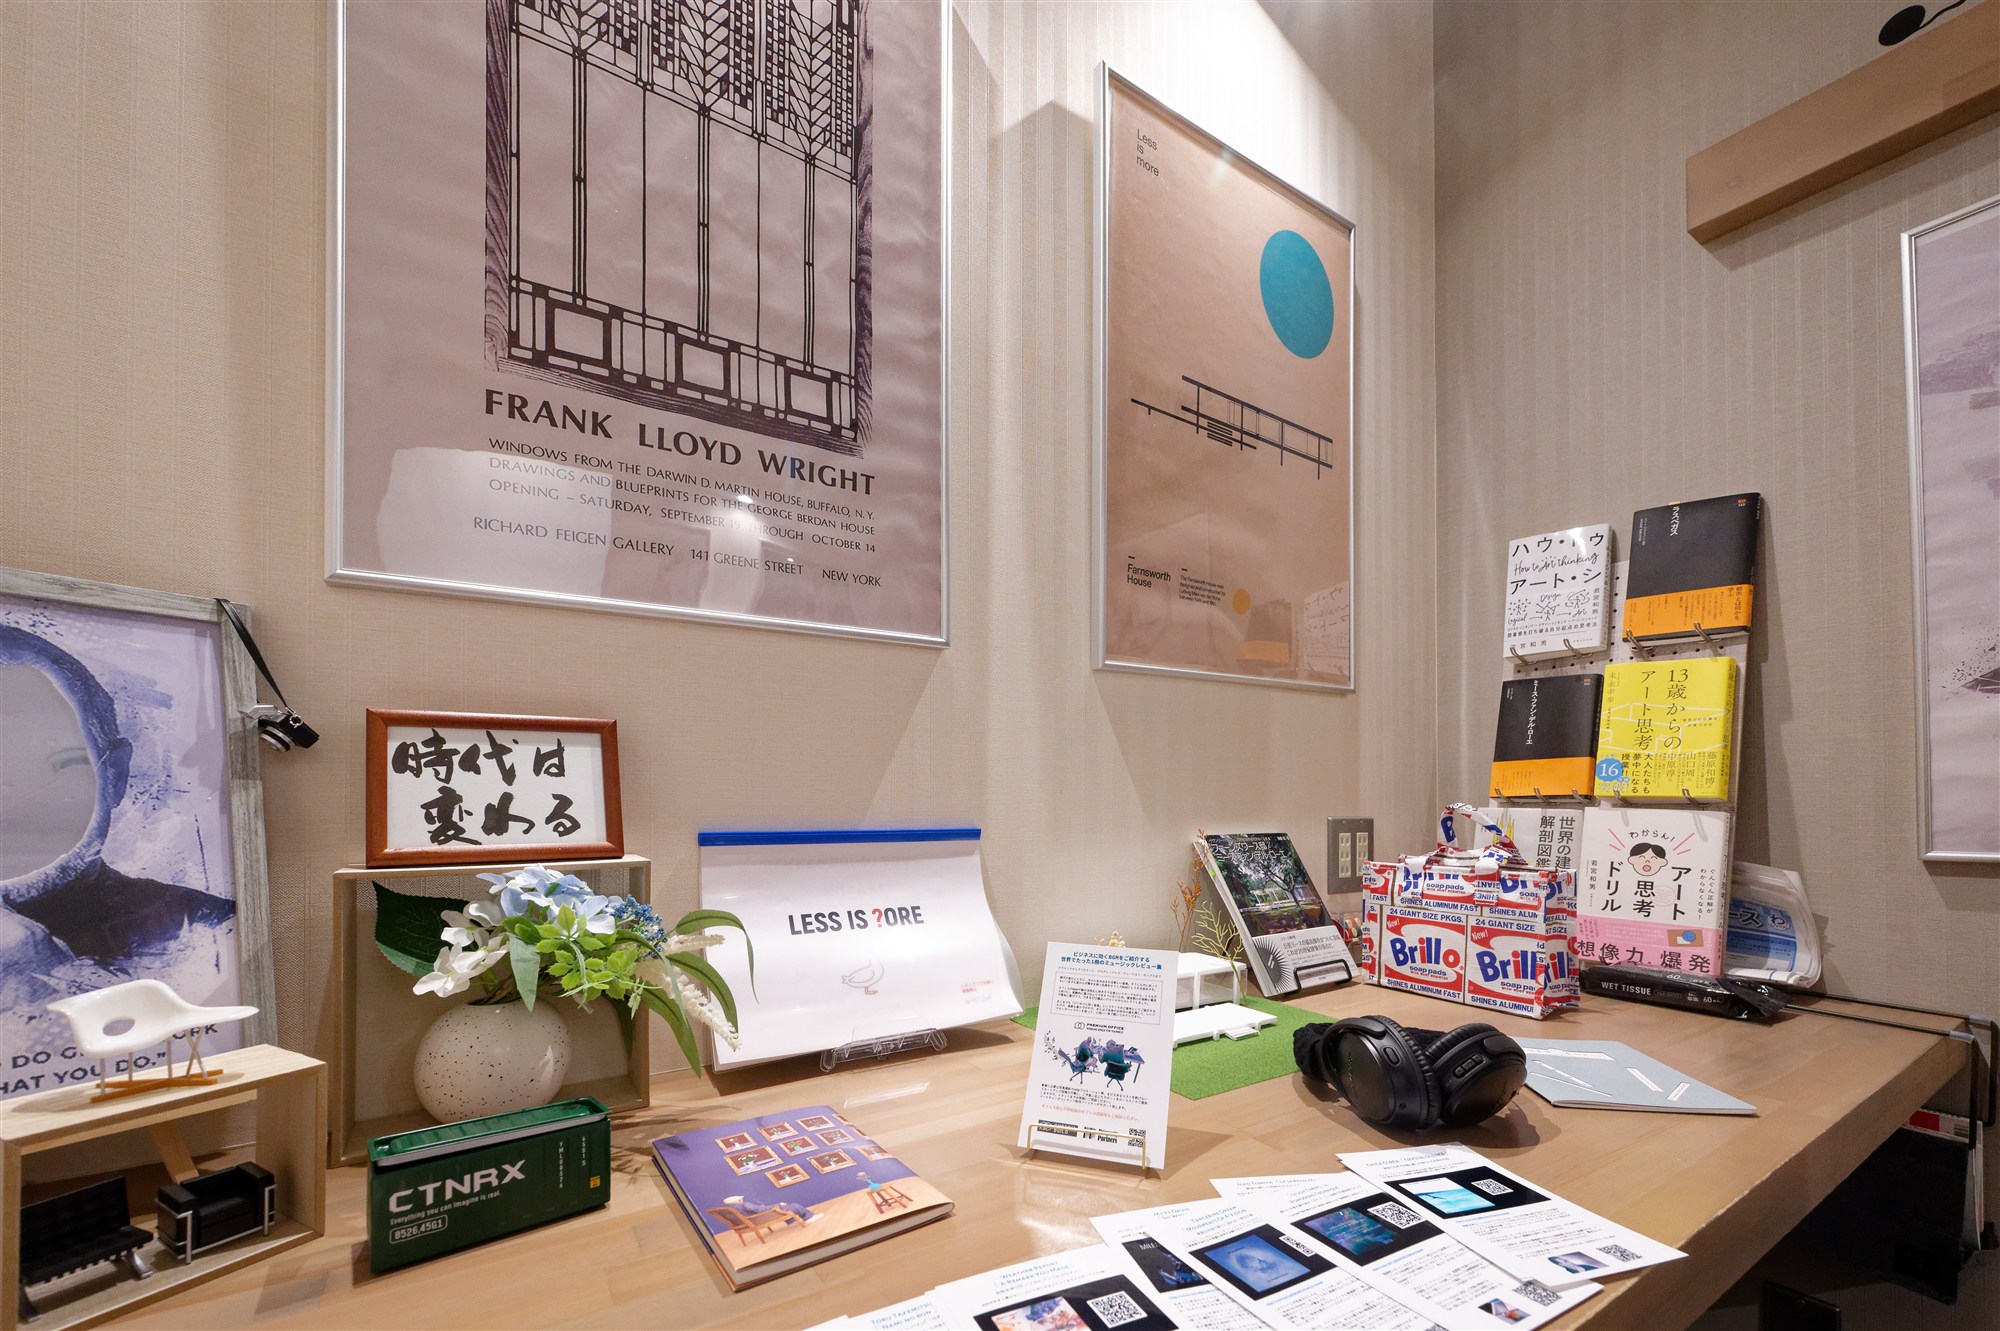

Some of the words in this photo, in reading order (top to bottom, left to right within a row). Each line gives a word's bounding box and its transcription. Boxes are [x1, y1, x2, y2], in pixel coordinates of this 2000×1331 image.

[1136, 140, 1144, 154] is
[1137, 128, 1158, 150] Less
[1136, 156, 1159, 176] more
[485, 388, 613, 439] FRANK
[638, 423, 742, 466] LLOYD
[758, 449, 875, 495] WRIGHT
[488, 437, 568, 462] WINDOWS
[574, 454, 613, 470] FROM
[618, 461, 641, 476] THE
[646, 466, 697, 486] DARWIN
[701, 478, 712, 489] D.
[714, 481, 760, 498] MARTIN
[764, 490, 804, 508] HOUSE,
[807, 500, 850, 517] BUFFALO,
[489, 456, 576, 481] DRAWINGS
[580, 474, 610, 488] AND
[615, 480, 689, 502] BLUEPRINTS
[694, 494, 717, 507] FOR
[721, 498, 743, 510] THE
[748, 503, 792, 521] GEORGE
[797, 514, 836, 529] BERDAN
[840, 524, 876, 536] HOUSE
[488, 478, 559, 501] OPENING
[579, 494, 653, 518] SATURDAY,
[660, 508, 725, 527] SEPTEMBER
[748, 524, 804, 541] THROUGH
[812, 534, 862, 551] OCTOBER
[866, 544, 876, 553] 14
[474, 516, 548, 538] RICHARD
[556, 528, 606, 546] FEIGEN
[612, 536, 675, 556] GALLERY
[691, 550, 709, 561] 141
[714, 552, 760, 570] GREENE
[764, 560, 804, 576] STREET
[822, 569, 849, 582] NEW
[852, 574, 881, 587] YORK
[1127, 564, 1172, 582] Farnsworth
[1514, 560, 1531, 576] How
[1127, 574, 1152, 588] House
[1510, 569, 1602, 595] アート・シ
[1633, 670, 1656, 751] アート思考
[1664, 668, 1688, 750] 13歳からの
[391, 727, 566, 786] 時代は
[1600, 762, 1619, 777] 16
[1631, 752, 1642, 794] 夢中になる
[1643, 752, 1654, 794] 大人たちも
[420, 786, 582, 846] 変わる
[1628, 828, 1676, 842] わからん!
[1426, 882, 1444, 890] soap
[1601, 860, 1624, 913] ドリル
[1671, 866, 1692, 920] アート
[1400, 898, 1423, 906] SHINES
[1424, 900, 1459, 910] ALUMINUM
[1460, 904, 1479, 912] FAST
[1632, 880, 1656, 918] 思考
[788, 911, 843, 936] LESS
[847, 909, 869, 930] IS
[871, 905, 925, 929] ?ORE
[1400, 910, 1421, 918] GIANT
[1422, 912, 1438, 920] SIZE
[1441, 915, 1464, 923] PKGS.
[1489, 908, 1516, 916] SHINES
[1387, 918, 1400, 928] New!
[1475, 918, 1486, 926] 24
[1488, 920, 1514, 930] GIANT
[1516, 924, 1536, 932] SIZE
[1471, 929, 1488, 941] New!
[1390, 937, 1460, 968] Brillo
[1410, 965, 1428, 974] soap
[1428, 968, 1446, 976] pads
[1476, 950, 1537, 982] Brill
[1387, 979, 1408, 989] SHINES
[1410, 983, 1442, 996] ALUMINUM
[1443, 990, 1461, 999] FAST
[1500, 981, 1522, 990] soap
[1601, 980, 1620, 992] WET
[1621, 984, 1652, 996] TISSUE
[1471, 996, 1498, 1006] SHINES
[1703, 996, 1713, 1004] 60
[12, 1050, 52, 1069] DO
[53, 1064, 100, 1084] YOU
[1097, 1134, 1118, 1144] Partners
[389, 1159, 526, 1214] CTNRX
[390, 1210, 426, 1226] Everything
[426, 1206, 438, 1216] you
[440, 1204, 452, 1212] can
[453, 1196, 479, 1208] imagine
[1000, 1268, 1033, 1279] WEATHER
[1033, 1261, 1058, 1270] REPORT
